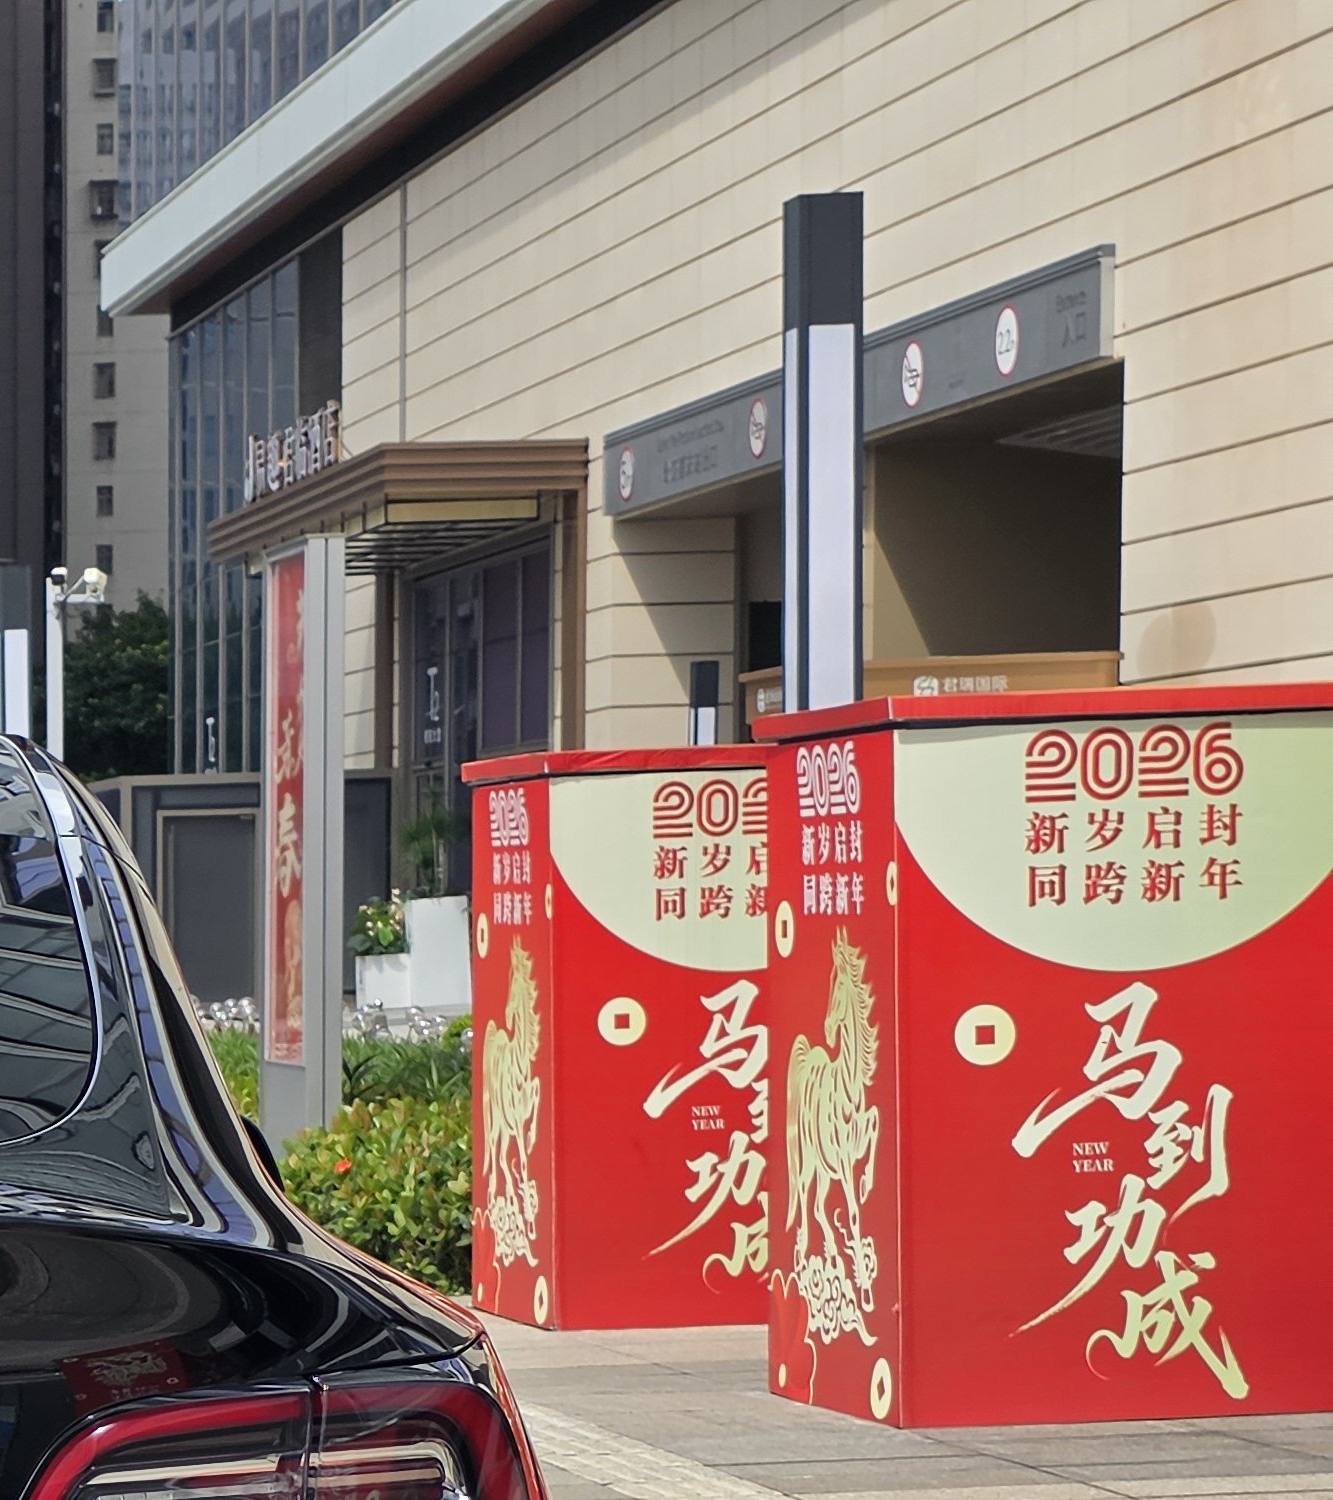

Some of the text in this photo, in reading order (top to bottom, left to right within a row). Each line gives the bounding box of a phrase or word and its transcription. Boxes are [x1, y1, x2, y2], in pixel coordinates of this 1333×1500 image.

[797, 740, 860, 817] 2026
[1025, 721, 1244, 803] 2026
[489, 787, 529, 847] 2026
[1025, 803, 1244, 855] 新岁启封
[801, 819, 863, 866] 新岁启封
[492, 850, 531, 885] 新岁启封
[1028, 856, 1244, 908] 同跨新年
[493, 890, 532, 926] 同跨新年
[803, 871, 864, 916] 同跨新年
[691, 1105, 721, 1117] NEW
[691, 1118, 725, 1131] YEAR
[1072, 1141, 1110, 1156] NEW
[1072, 1158, 1115, 1173] YEAR
[1007, 981, 1250, 1400] 马到功成
